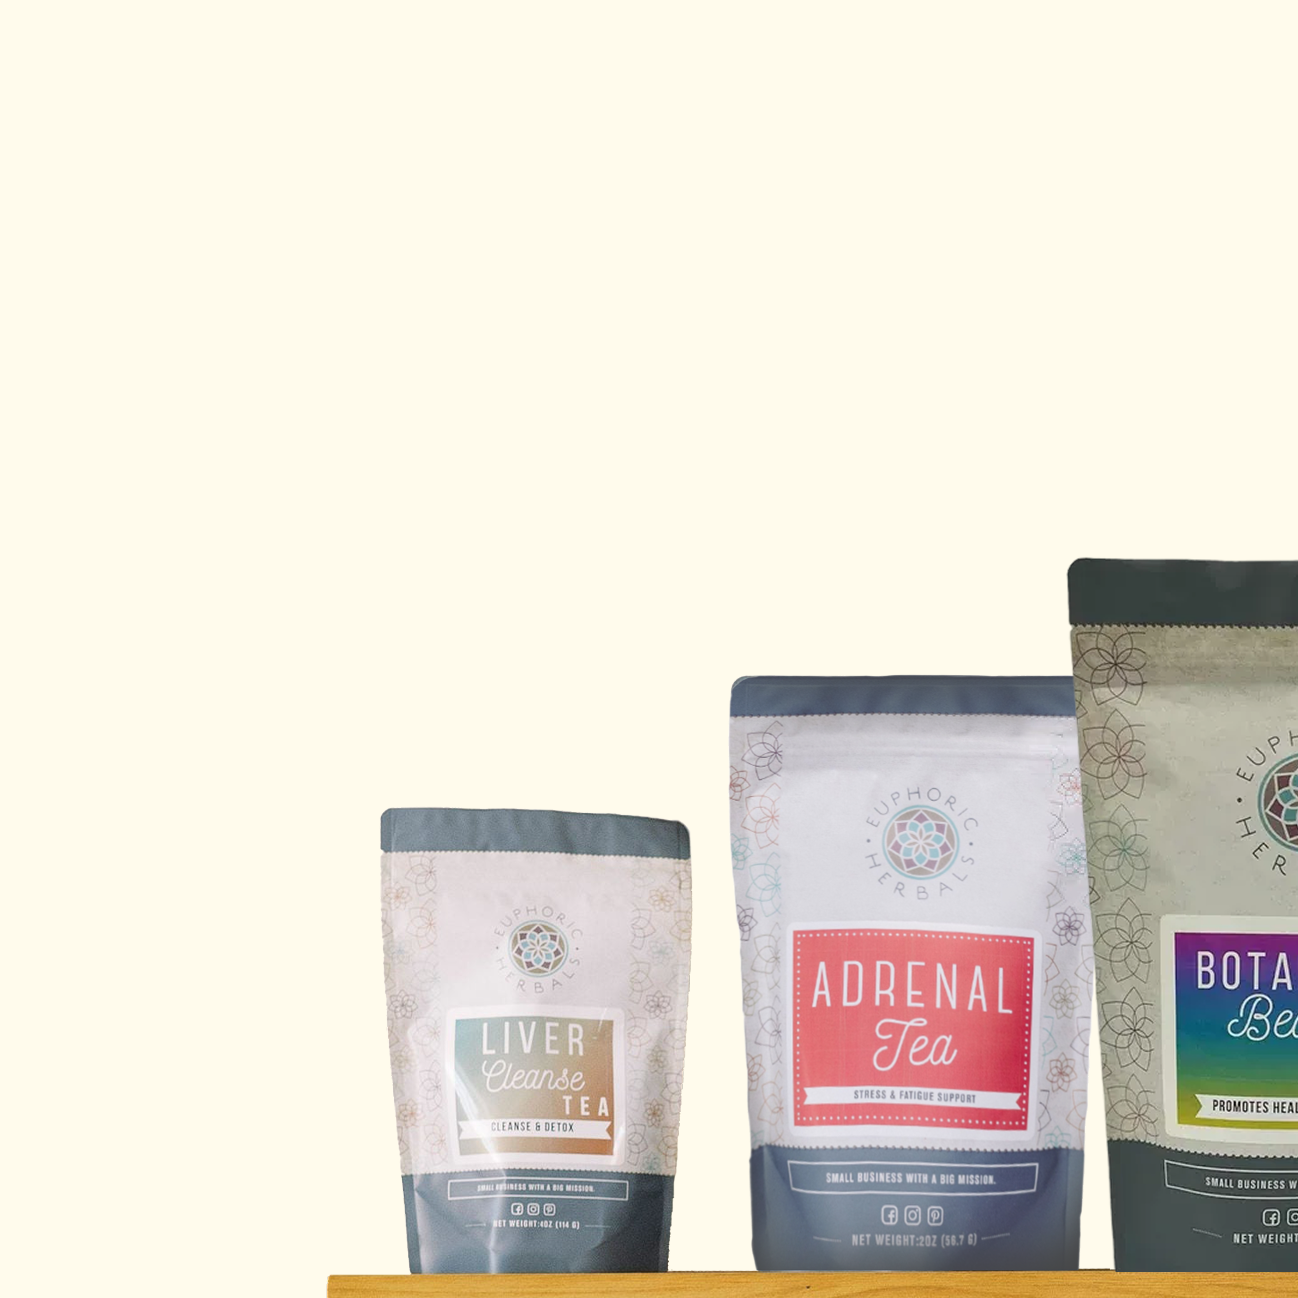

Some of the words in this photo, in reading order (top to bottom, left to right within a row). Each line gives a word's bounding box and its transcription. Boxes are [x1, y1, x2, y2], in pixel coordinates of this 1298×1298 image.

[866, 787, 978, 831] EUPHORIC
[865, 853, 974, 900] HERBALS
[494, 906, 583, 939] EUPHORIC
[496, 957, 580, 993] HERBALS
[812, 961, 1013, 1014] ADRENAL
[482, 1021, 584, 1056] LIVER
[873, 1018, 957, 1071] Tea
[482, 1059, 586, 1093] Cleanse
[854, 1090, 886, 1099] STRESS
[890, 1090, 896, 1099] &
[900, 1091, 934, 1101] FATIGUE
[938, 1093, 976, 1103] SUPPORT
[562, 1095, 609, 1117] TEA
[1213, 1100, 1269, 1113] PROMOTES
[491, 1122, 531, 1131] CLEANSE
[535, 1122, 540, 1131] &
[544, 1122, 574, 1132] DETOX
[478, 1184, 493, 1192] SMALL
[496, 1183, 526, 1191] BUSINESS
[826, 1172, 854, 1183] SMALL
[857, 1172, 902, 1183] BUSINESS
[906, 1174, 928, 1183] WITH
[932, 1175, 937, 1183] A
[940, 1175, 955, 1184] BIG
[958, 1175, 996, 1185] MISSION.
[1206, 1177, 1234, 1188] SMALL
[1238, 1180, 1285, 1189] BUSINESS
[493, 1220, 506, 1228] NET
[556, 1220, 570, 1228] (114
[852, 1234, 871, 1246] NET
[941, 1234, 964, 1248] (56.7
[968, 1233, 977, 1246] G)
[1233, 1233, 1253, 1243] NET
